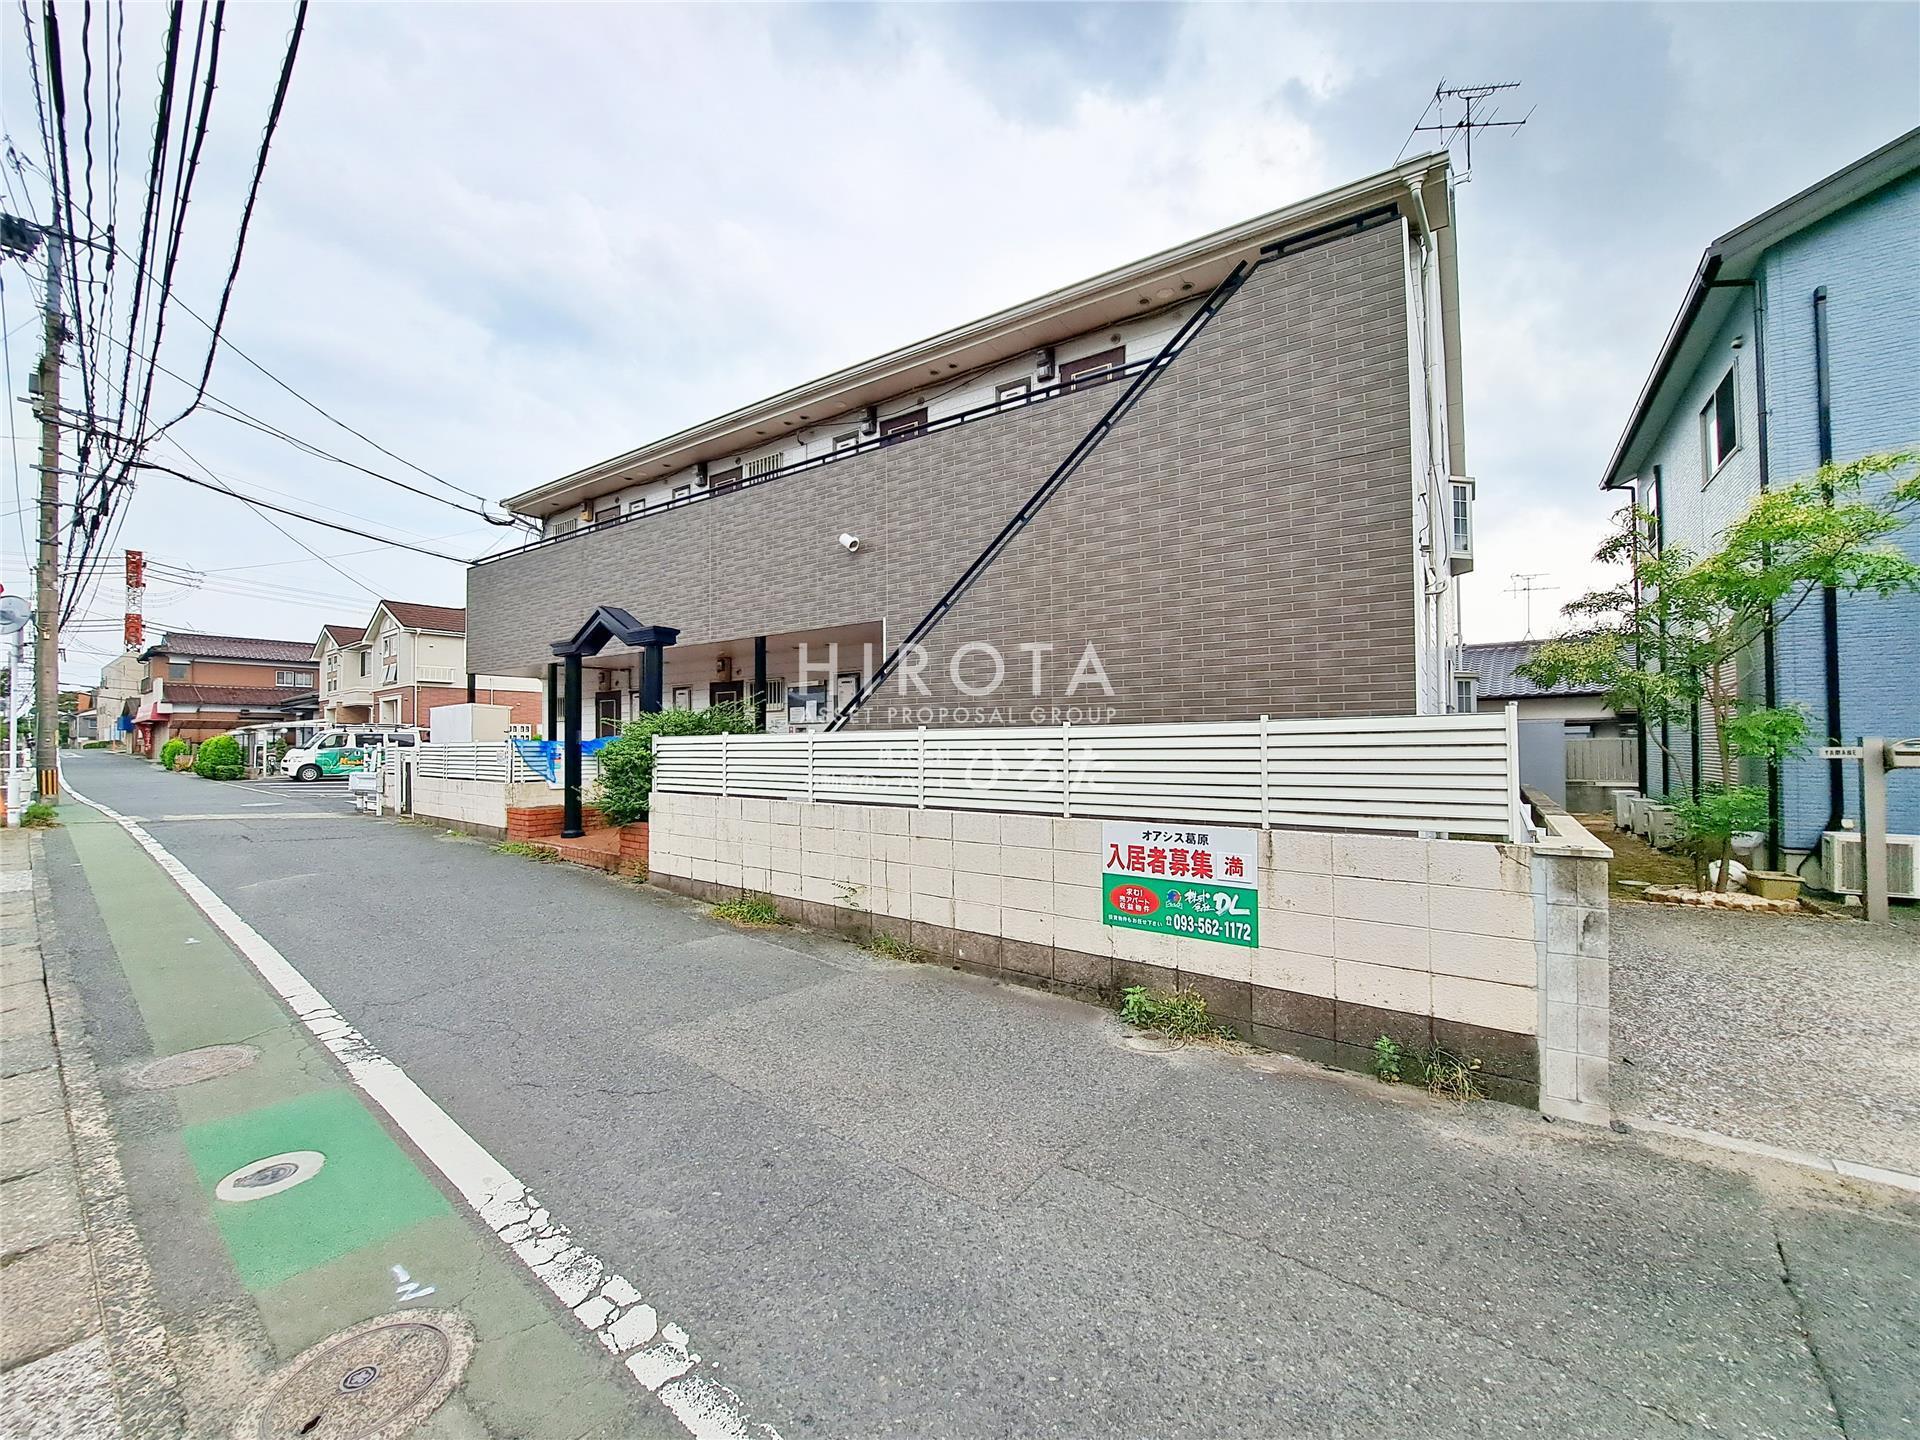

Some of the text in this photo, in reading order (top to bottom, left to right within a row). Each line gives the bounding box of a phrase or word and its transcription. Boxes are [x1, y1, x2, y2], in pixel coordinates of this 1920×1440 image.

[1142, 830, 1209, 846] オアシス葛原
[1107, 843, 1244, 879] 入居者募集 満
[1213, 892, 1251, 916] DL
[1173, 914, 1251, 941] 093-562-1172
